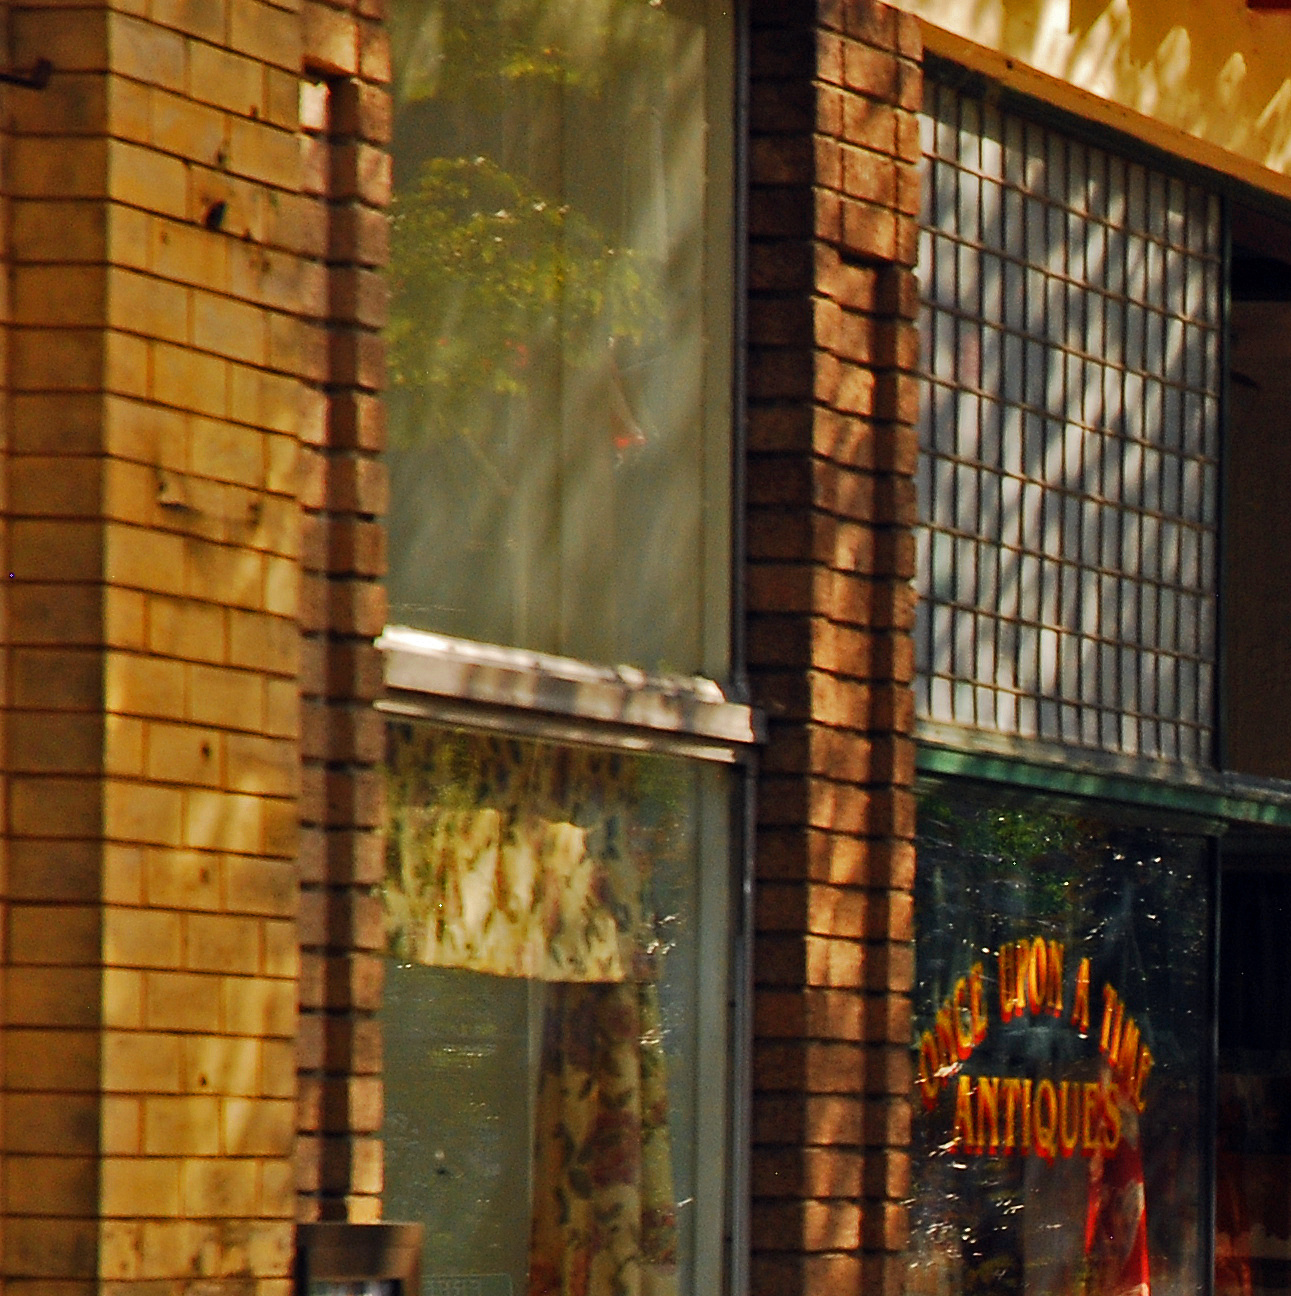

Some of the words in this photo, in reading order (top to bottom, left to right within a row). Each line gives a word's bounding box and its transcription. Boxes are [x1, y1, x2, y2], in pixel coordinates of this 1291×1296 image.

[920, 958, 988, 1108] ONCE
[999, 936, 1065, 1022] UPON
[1070, 956, 1090, 1033] A
[953, 1075, 1123, 1166] ANTIQUES
